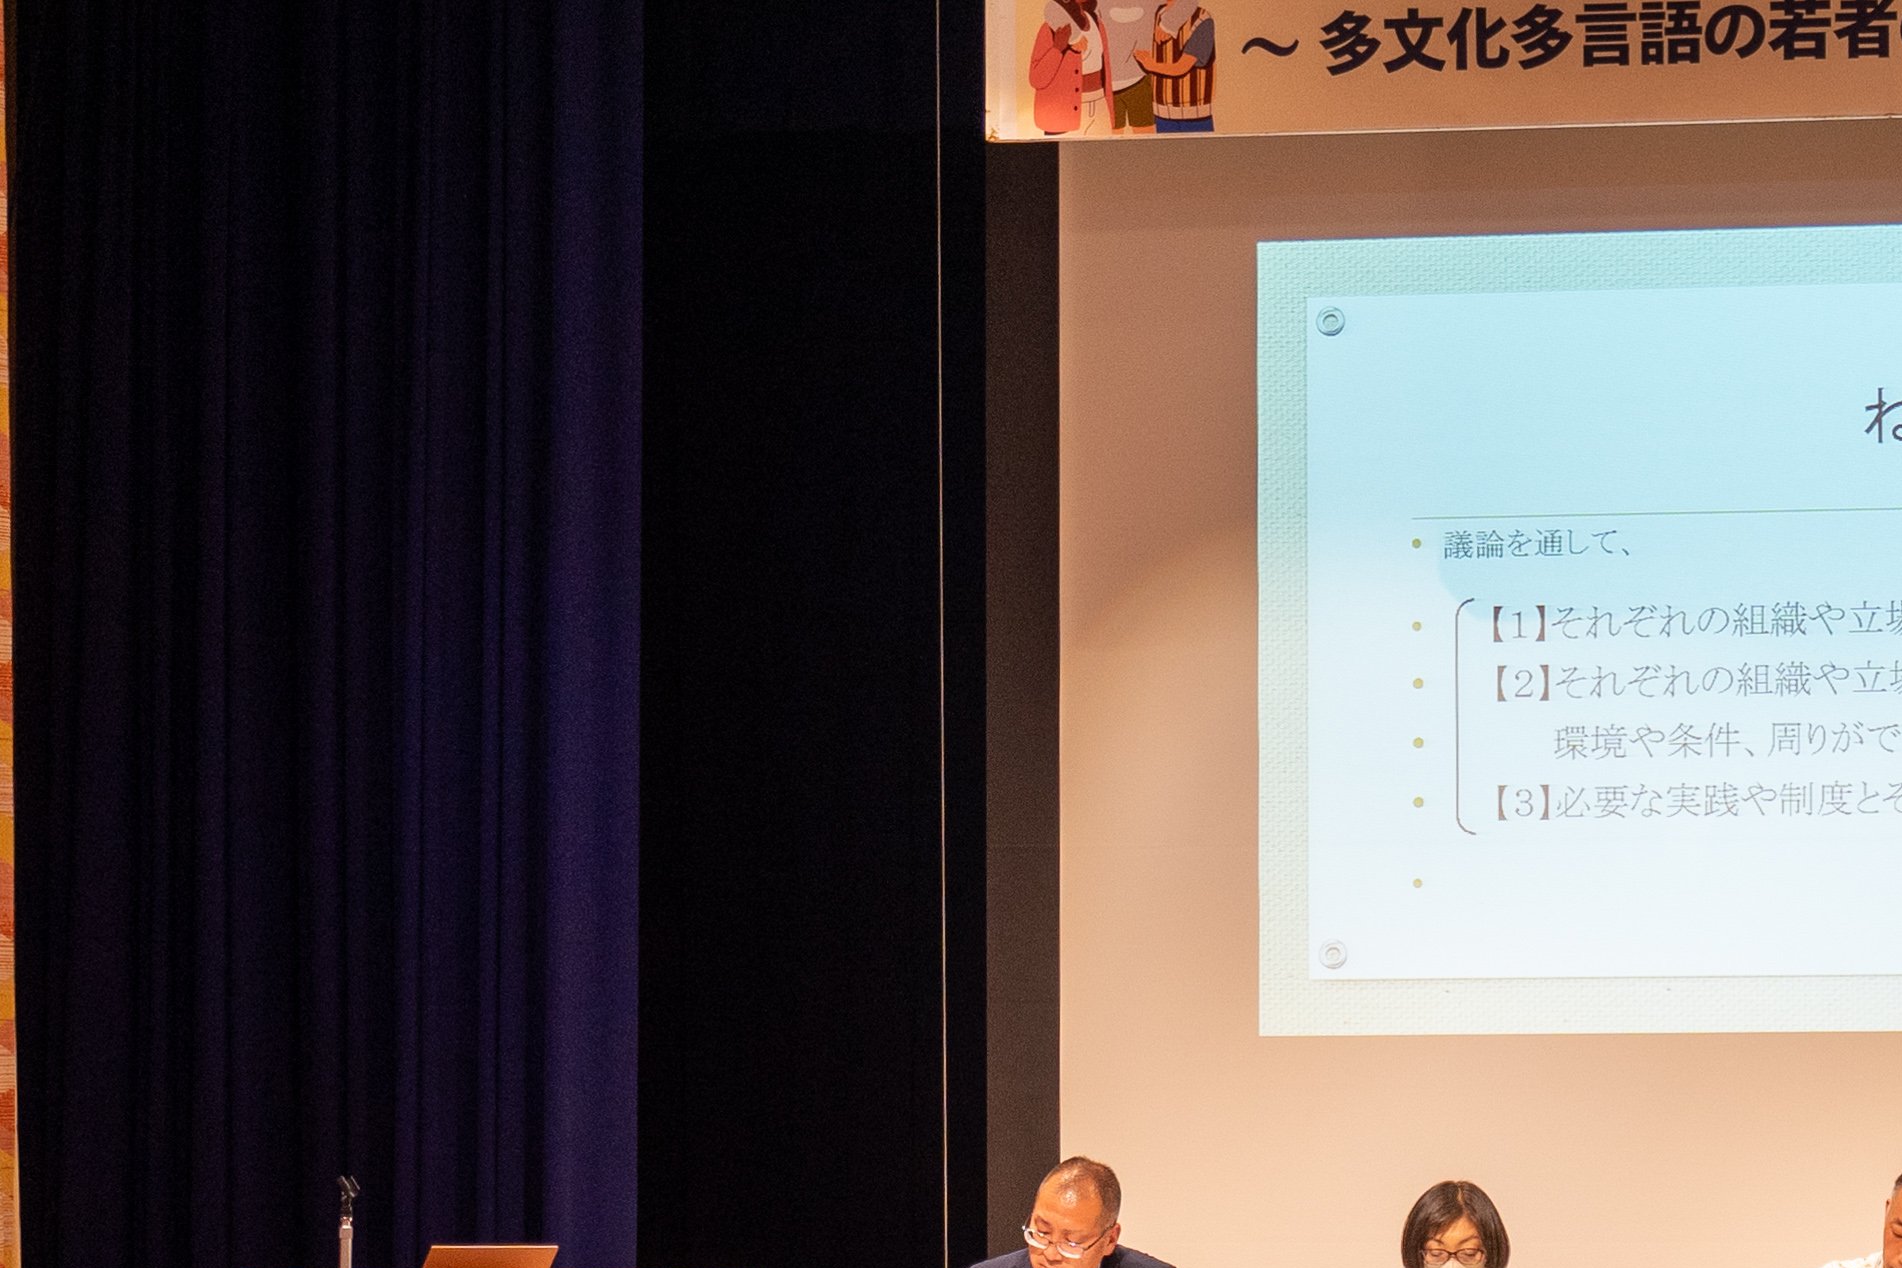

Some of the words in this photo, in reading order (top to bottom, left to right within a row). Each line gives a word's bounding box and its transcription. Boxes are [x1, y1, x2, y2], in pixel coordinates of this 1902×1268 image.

[1444, 529, 1630, 559] 議論を通して、
